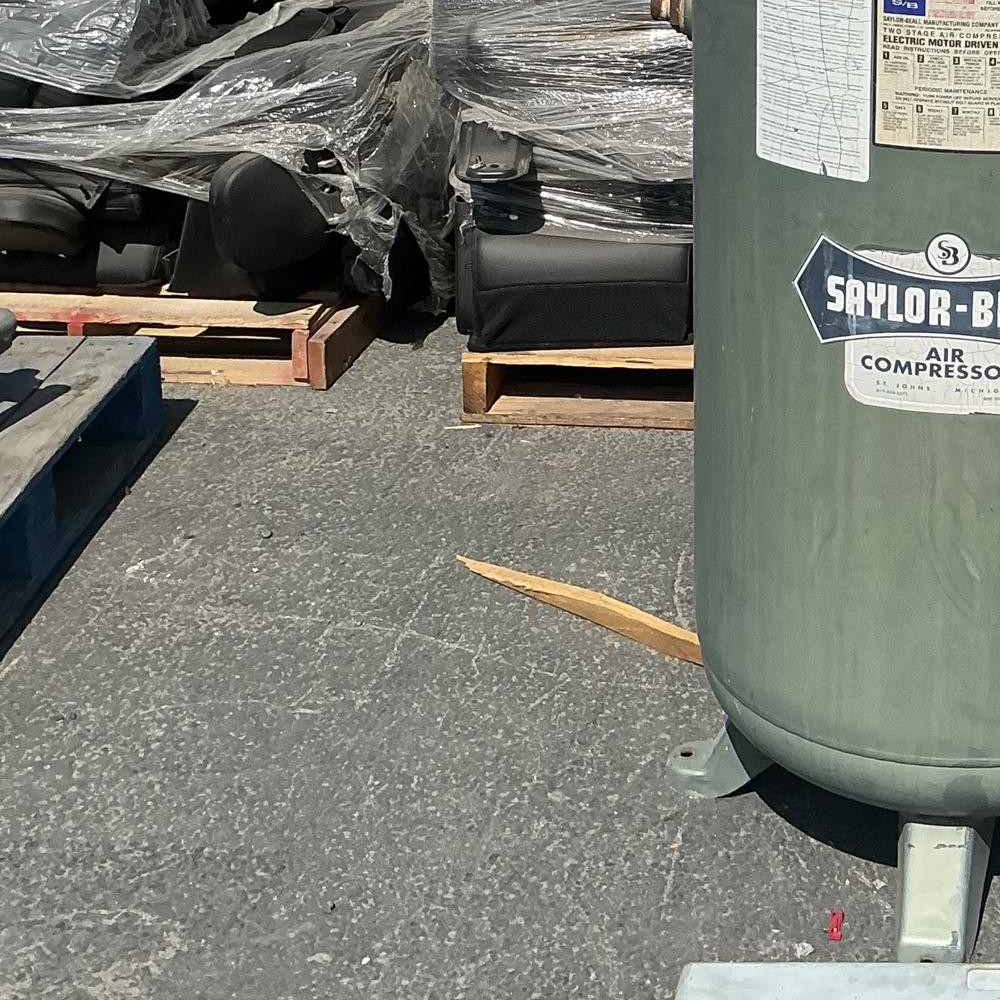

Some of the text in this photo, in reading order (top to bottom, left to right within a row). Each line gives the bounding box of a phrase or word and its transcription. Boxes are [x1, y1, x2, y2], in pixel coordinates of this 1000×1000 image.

[883, 16, 921, 24] SAYLOR-BEALL
[923, 19, 970, 28] MANUFACTURING
[883, 35, 925, 45] ELECTRIC
[928, 38, 962, 48] MOTOR
[965, 40, 998, 49] DRIVEN
[903, 46, 950, 54] INSTRUCTIONS
[925, 347, 965, 363] AIR
